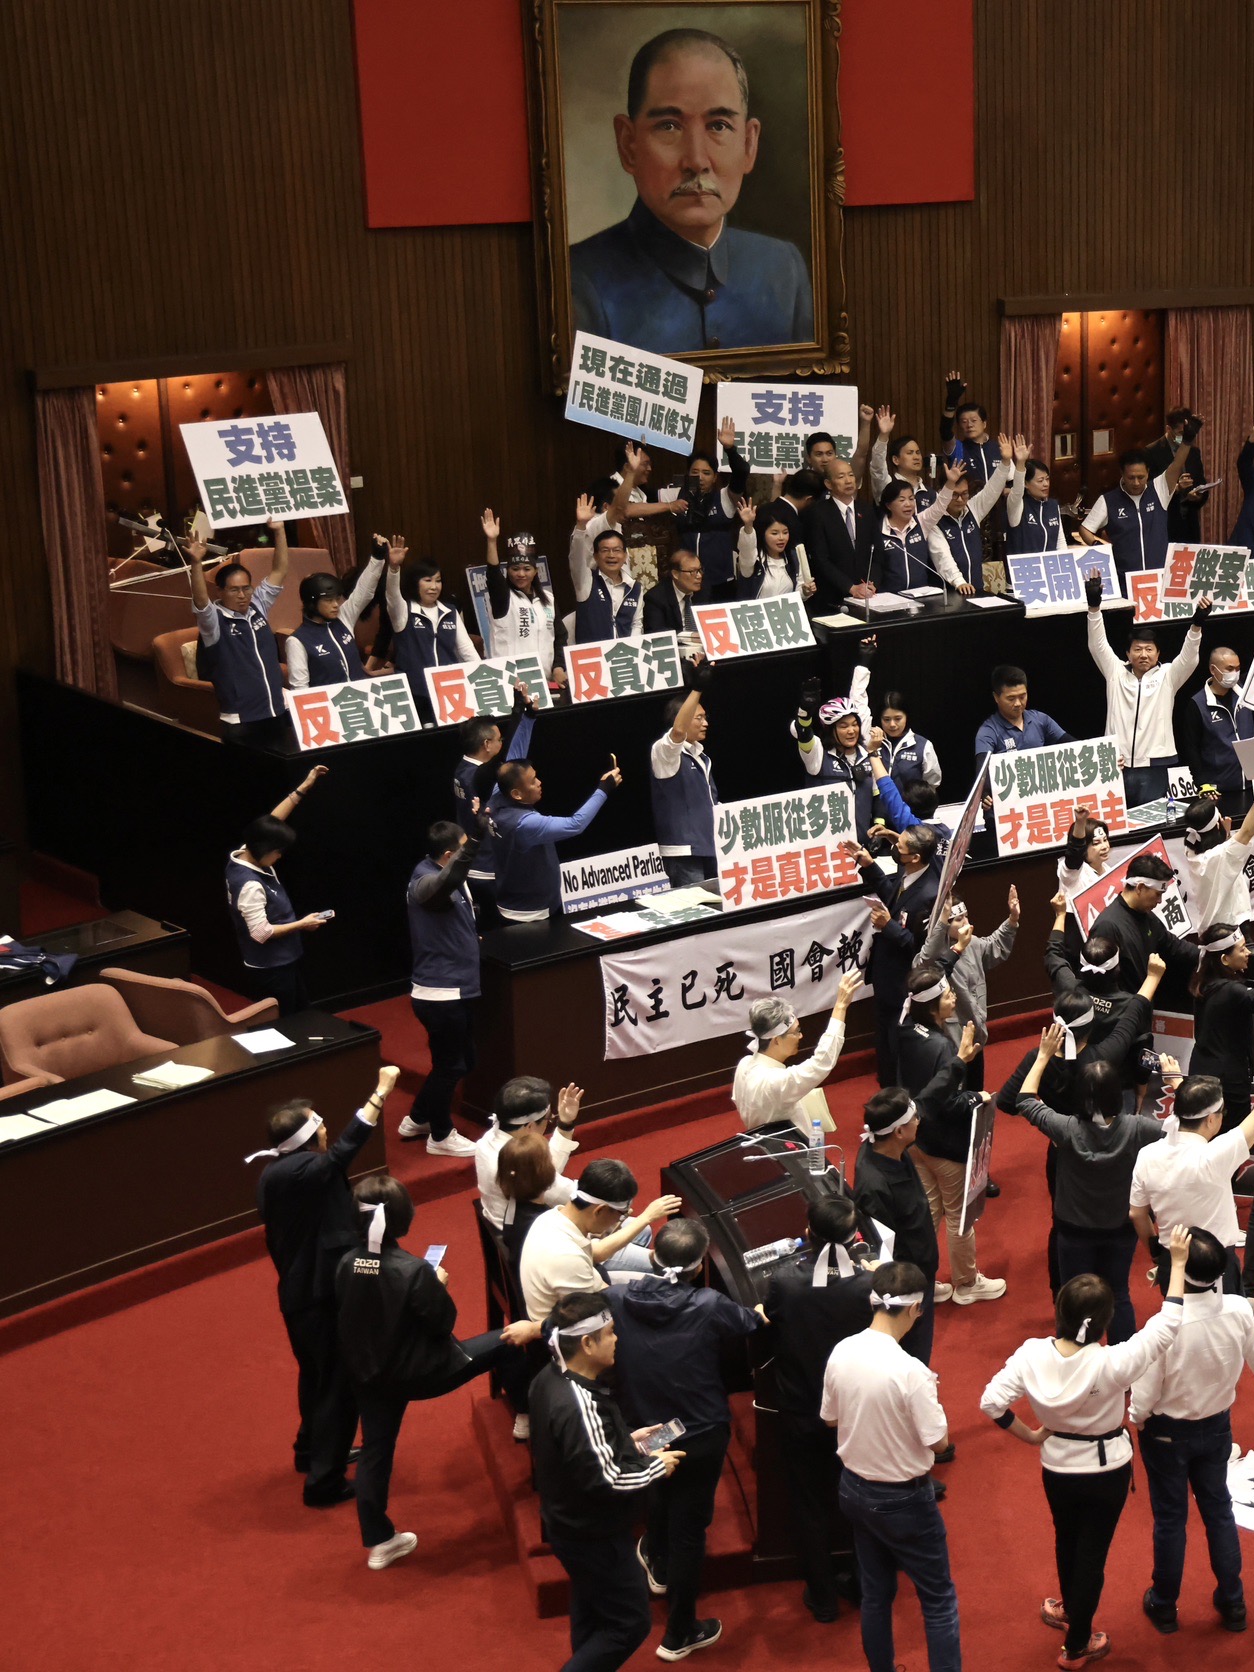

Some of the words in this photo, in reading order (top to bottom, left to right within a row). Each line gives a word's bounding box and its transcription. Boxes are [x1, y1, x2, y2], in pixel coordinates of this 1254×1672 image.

[579, 345, 689, 404] 現在通過
[571, 381, 695, 442] 「民進黨團」版條文
[751, 390, 824, 427] 支持
[217, 421, 297, 467] 支持
[203, 466, 343, 521] 民進黨提案
[1164, 546, 1245, 599] 查弊案
[696, 598, 809, 657] 反腐敗
[431, 656, 547, 723] 反貪污
[569, 635, 679, 702] 反貪污
[292, 678, 416, 748] 反貪污
[994, 742, 1120, 802] 少數服從多數
[718, 790, 852, 855] 少數服從多數
[563, 869, 580, 894] No
[581, 858, 632, 890] Advanced
[722, 842, 858, 906] 才是真民主
[610, 960, 745, 1027] 民主已死
[1092, 995, 1112, 1008] 020
[353, 1258, 381, 1268] 2020
[353, 1267, 379, 1276] TAIWAN
